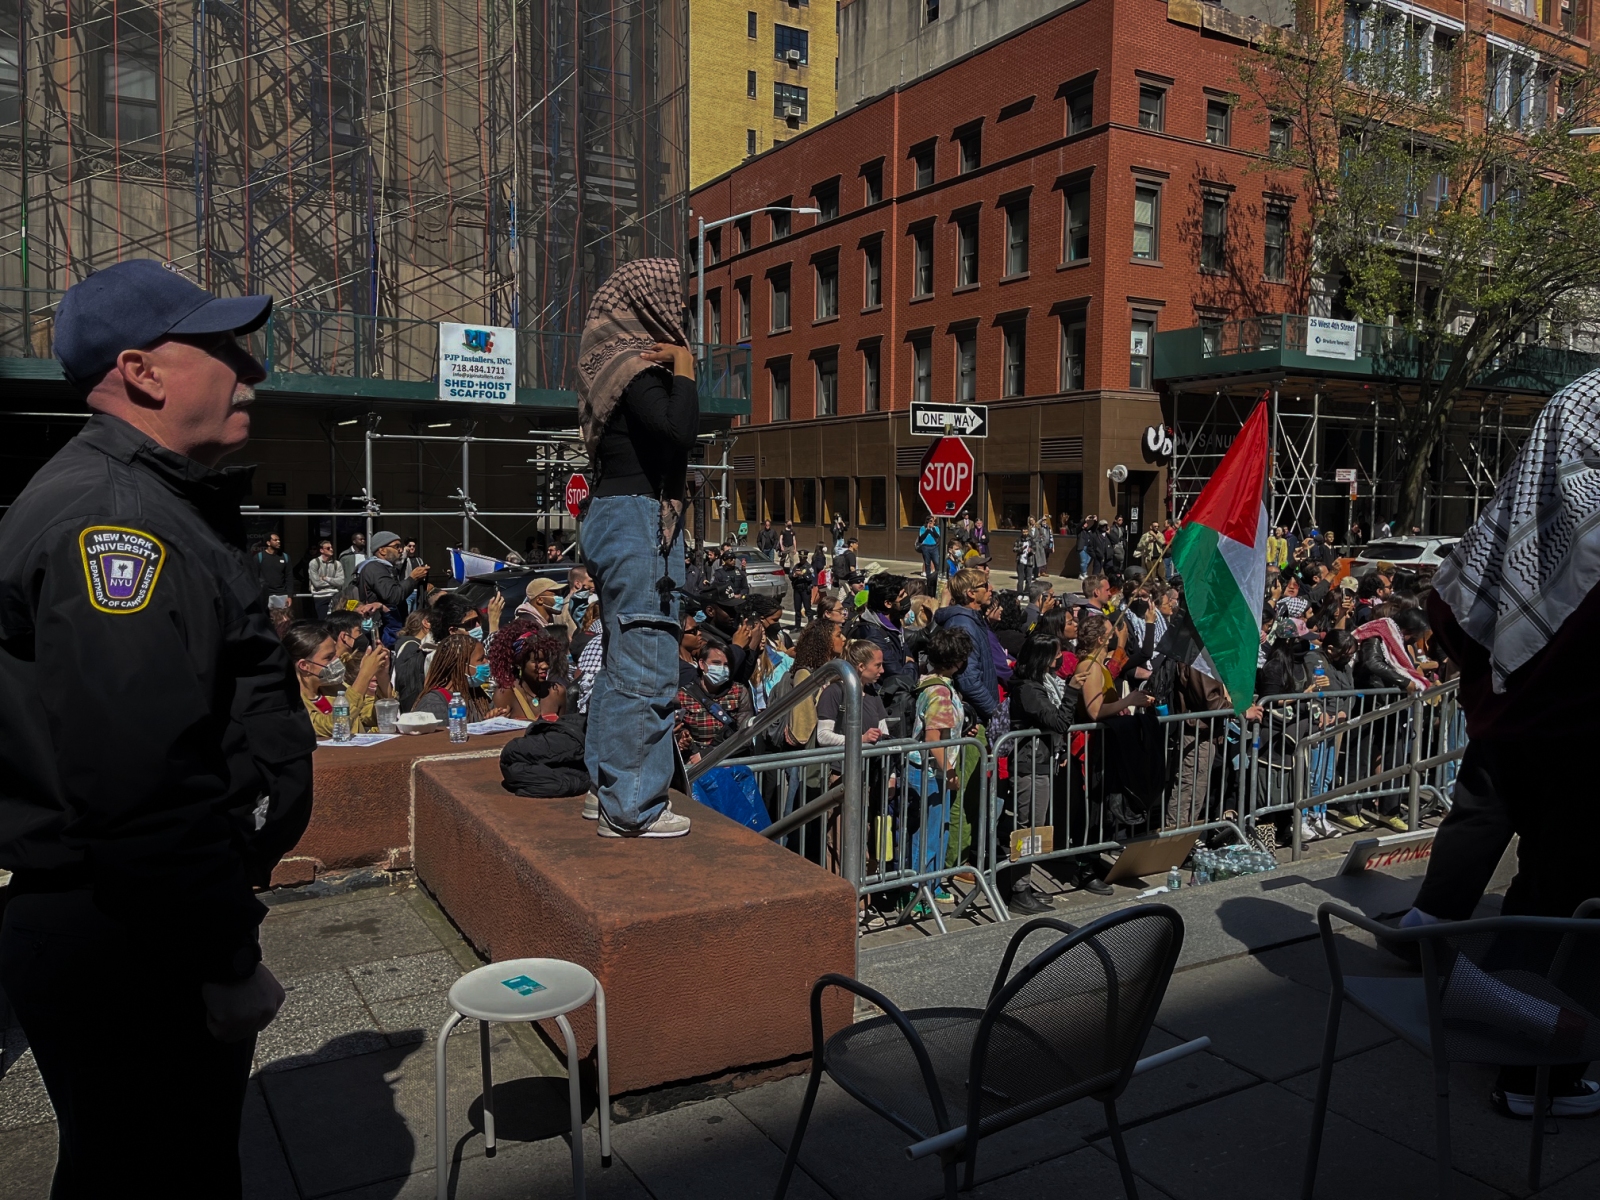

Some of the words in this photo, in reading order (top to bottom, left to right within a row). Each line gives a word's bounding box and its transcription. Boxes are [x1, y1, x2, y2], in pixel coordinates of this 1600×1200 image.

[1310, 319, 1317, 327] 25
[1318, 320, 1330, 328] West
[1331, 322, 1339, 330] 4th
[1340, 322, 1355, 332] Street
[461, 355, 495, 364] Installers,
[451, 364, 505, 375] 718.484.1711
[450, 389, 506, 399] SCAFFOLD
[922, 413, 944, 425] ONE
[954, 415, 976, 427] WAY
[923, 462, 969, 491] STOP
[567, 488, 587, 504] STOP
[93, 533, 120, 543] NEW
[122, 534, 153, 550] YORK
[87, 543, 159, 560] UNIVERSITY
[89, 559, 108, 605] DEPARTMENT
[121, 589, 146, 607] CAMPUS
[141, 565, 155, 589] SAFETY
[110, 578, 132, 587] NYU
